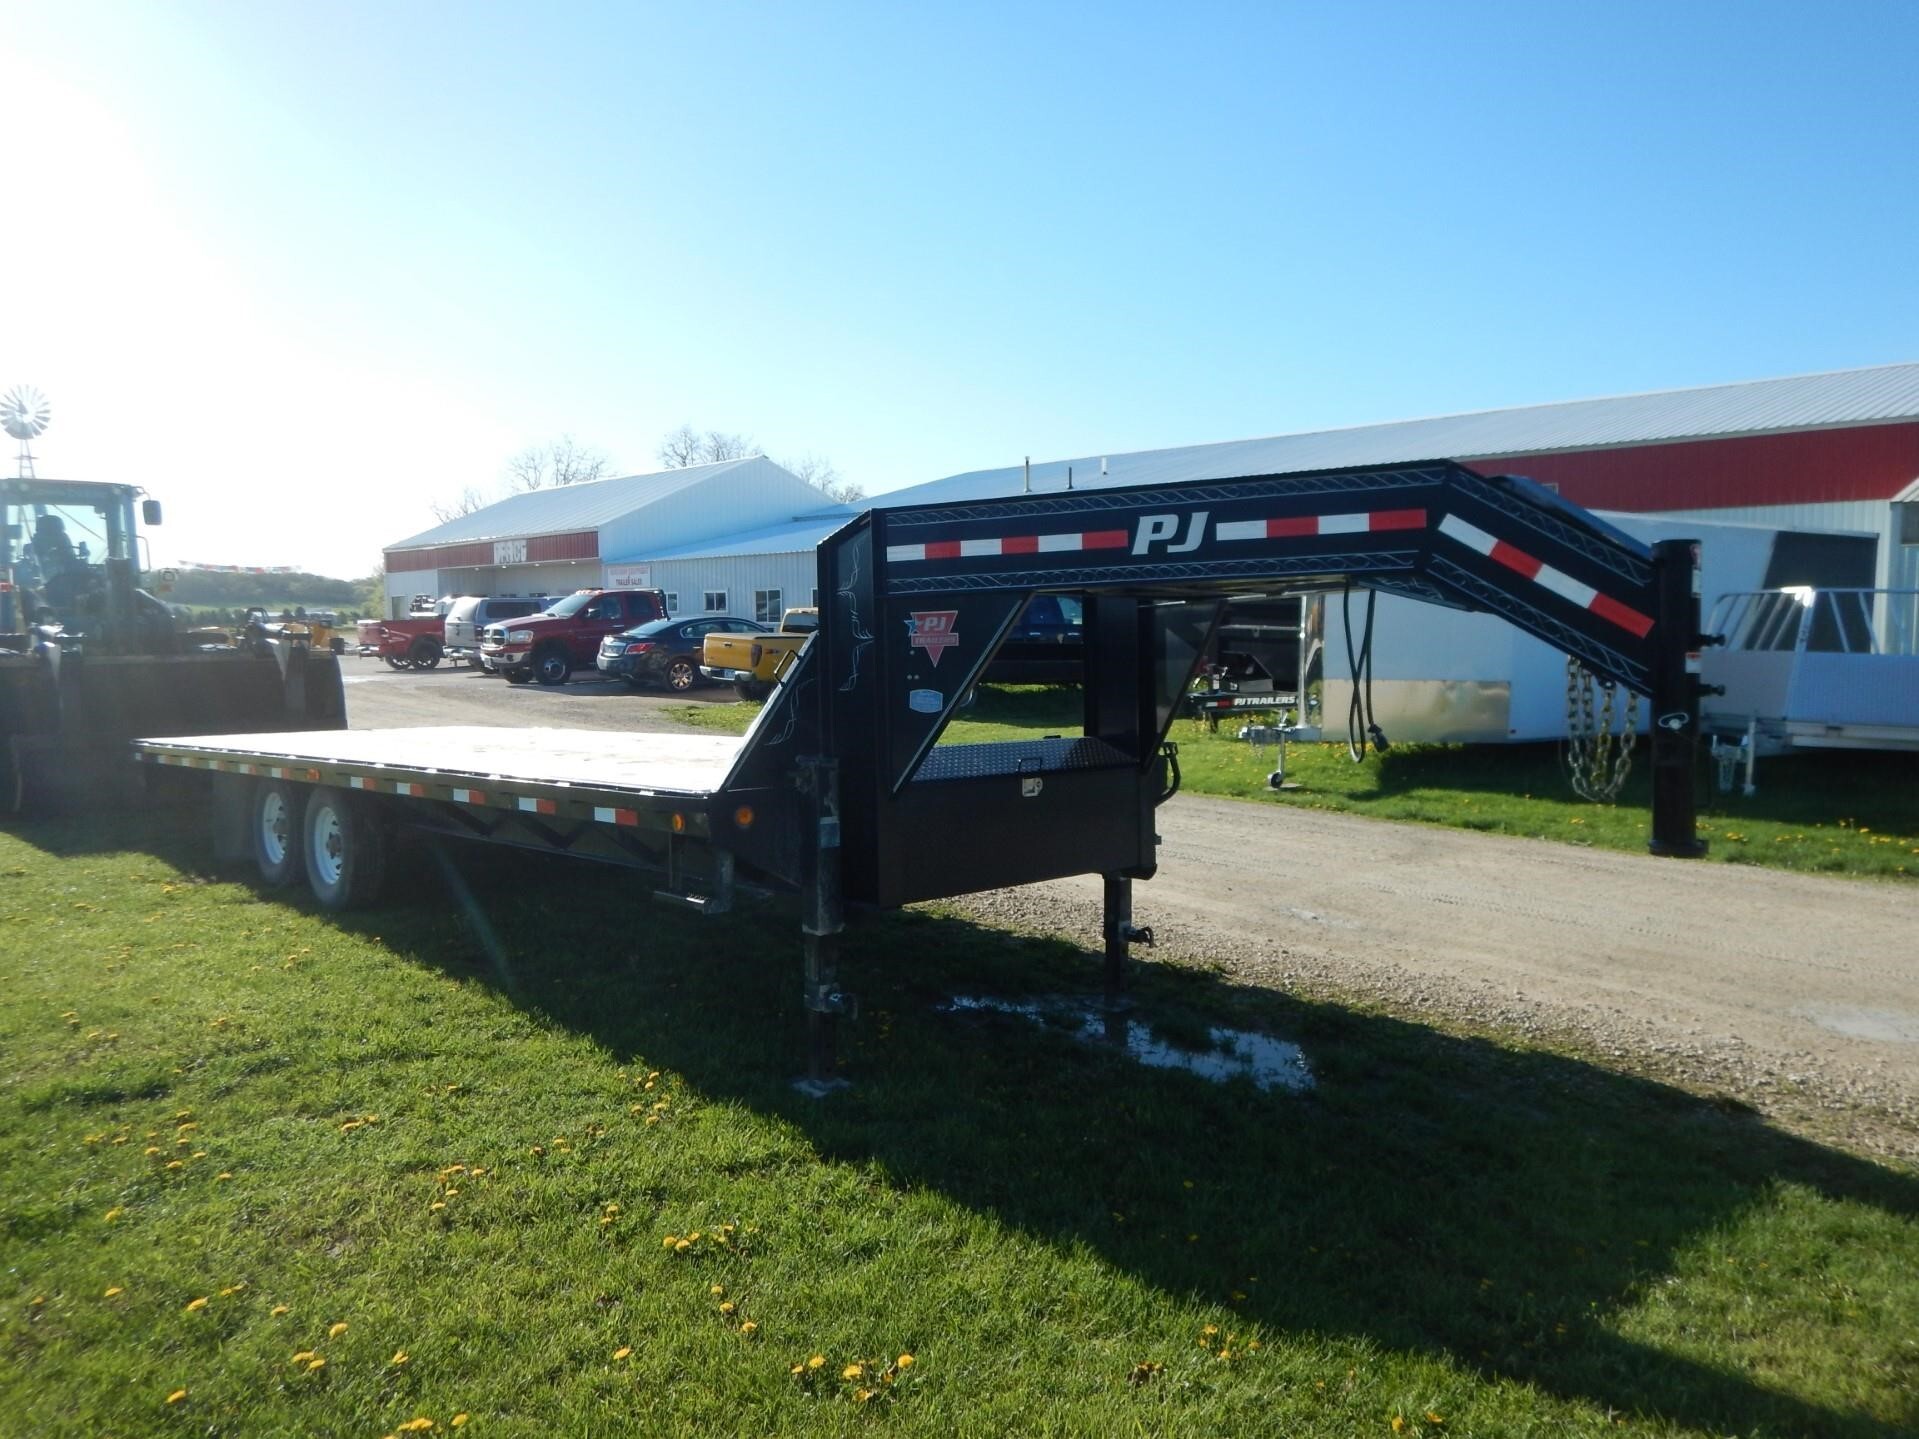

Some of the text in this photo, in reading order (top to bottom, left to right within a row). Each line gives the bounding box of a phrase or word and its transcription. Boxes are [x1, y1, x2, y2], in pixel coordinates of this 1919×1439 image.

[1131, 511, 1209, 555] PJ
[924, 616, 947, 631] PJ
[1247, 696, 1296, 705] TRAILERS
